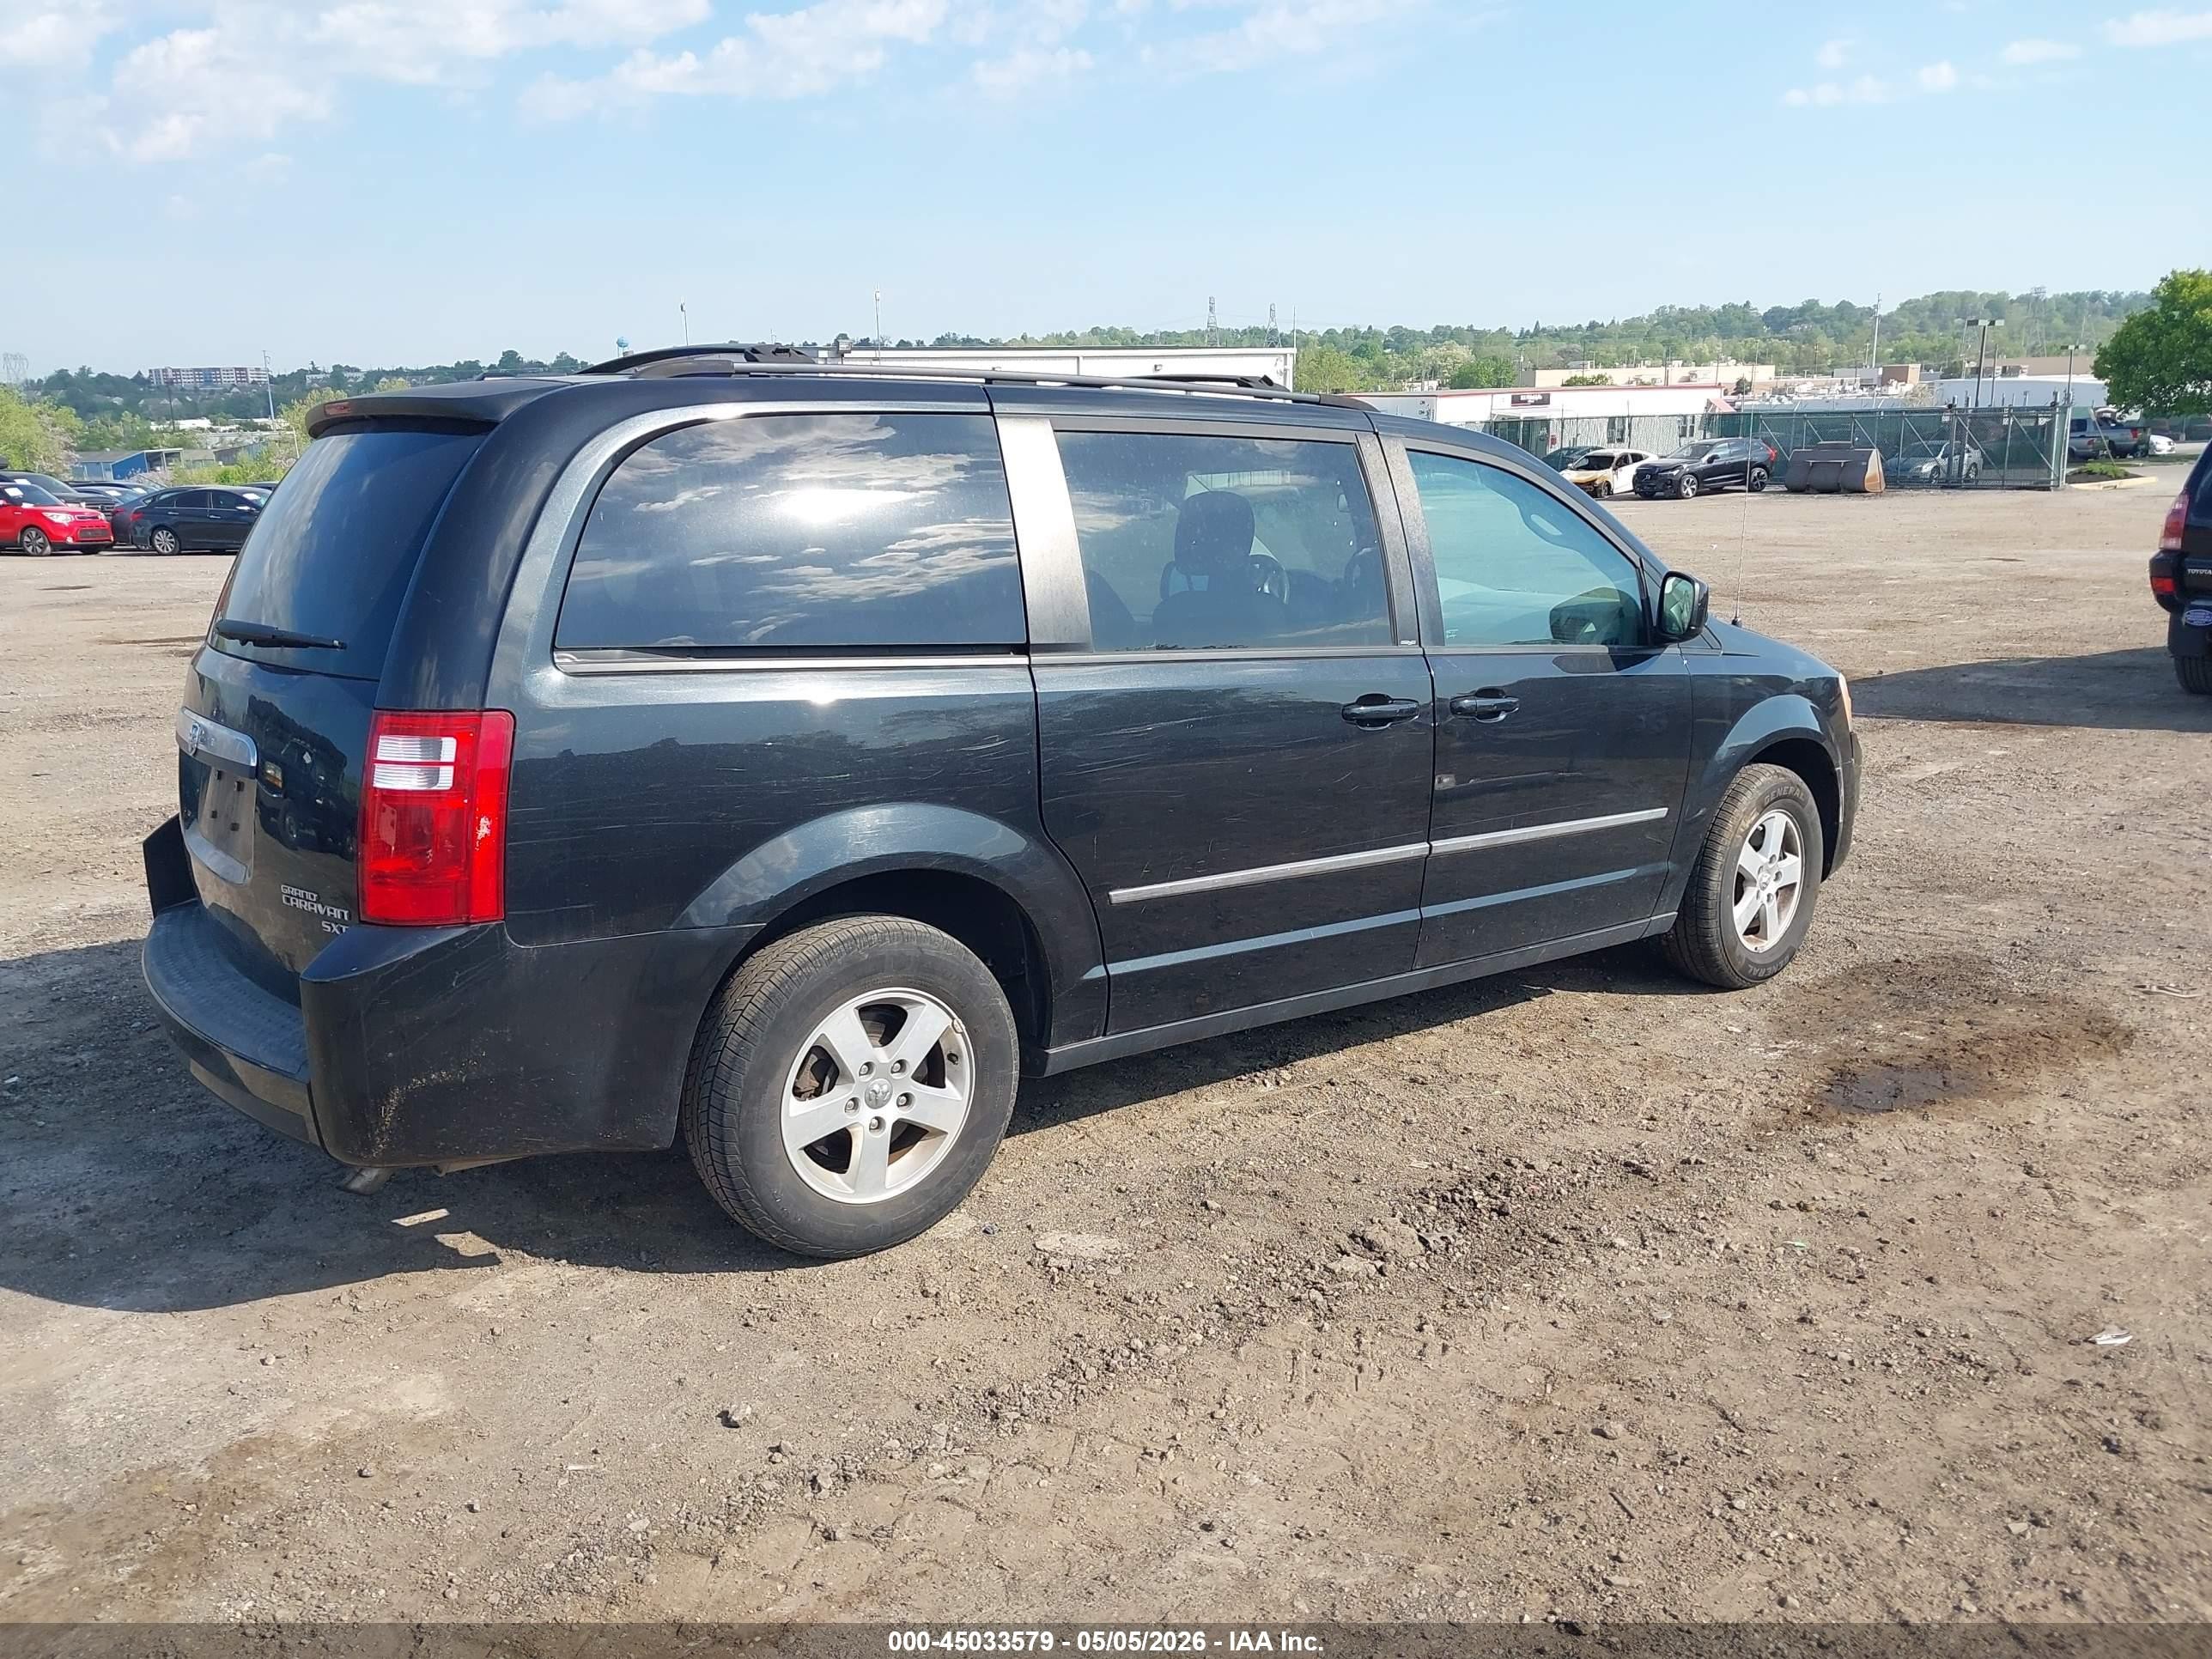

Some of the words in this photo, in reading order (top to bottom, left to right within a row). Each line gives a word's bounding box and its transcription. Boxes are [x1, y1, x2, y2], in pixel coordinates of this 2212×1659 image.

[281, 884, 318, 902] GRAND
[282, 894, 349, 921] CARAVAN
[321, 921, 349, 935] SXT
